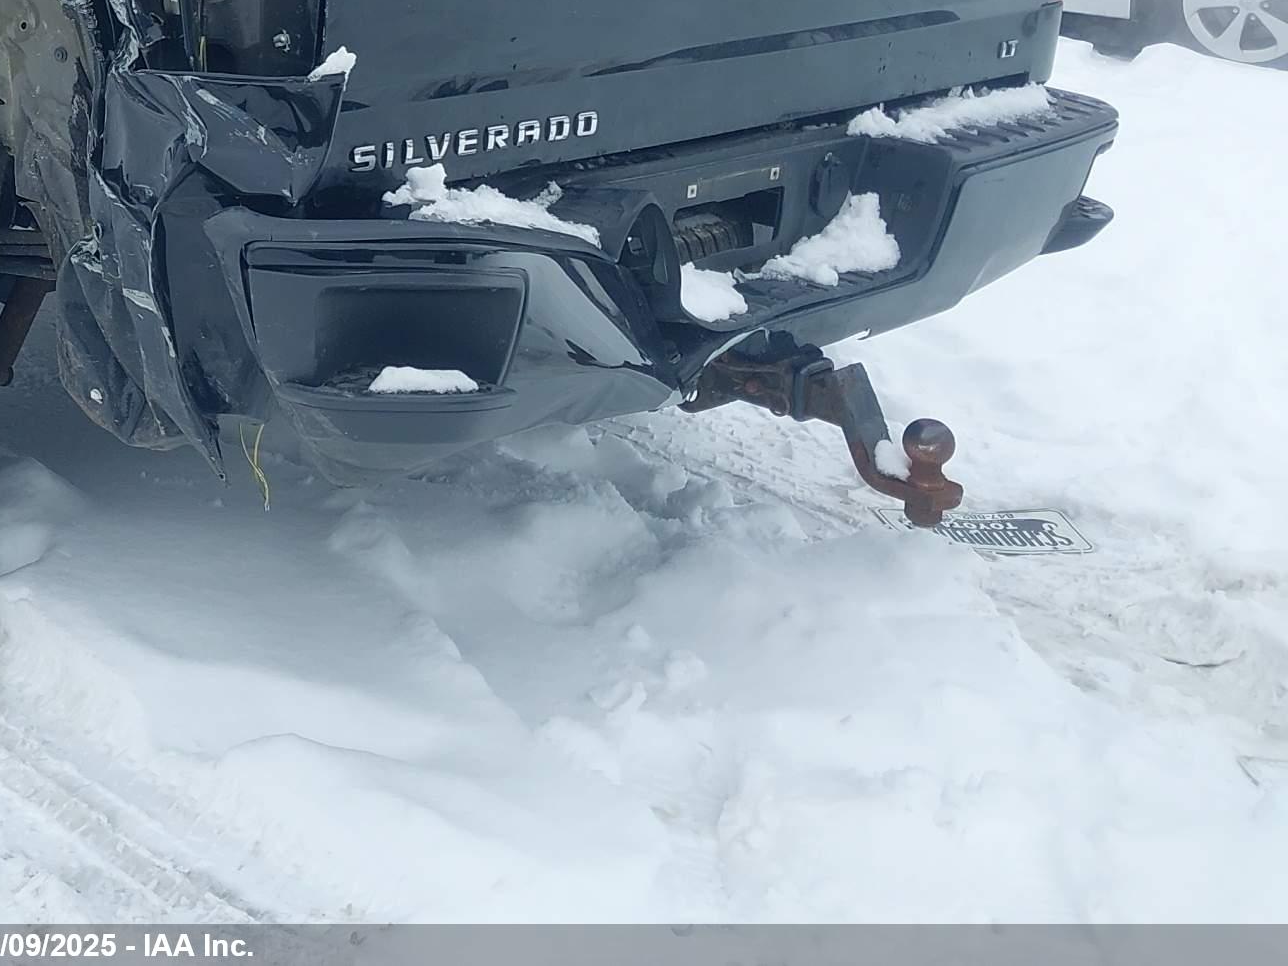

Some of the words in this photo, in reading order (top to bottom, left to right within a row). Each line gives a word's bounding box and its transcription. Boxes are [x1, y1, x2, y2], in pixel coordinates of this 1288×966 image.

[999, 39, 1019, 58] LT
[350, 111, 598, 172] SILVERADO
[940, 521, 1018, 530] TOYOTA
